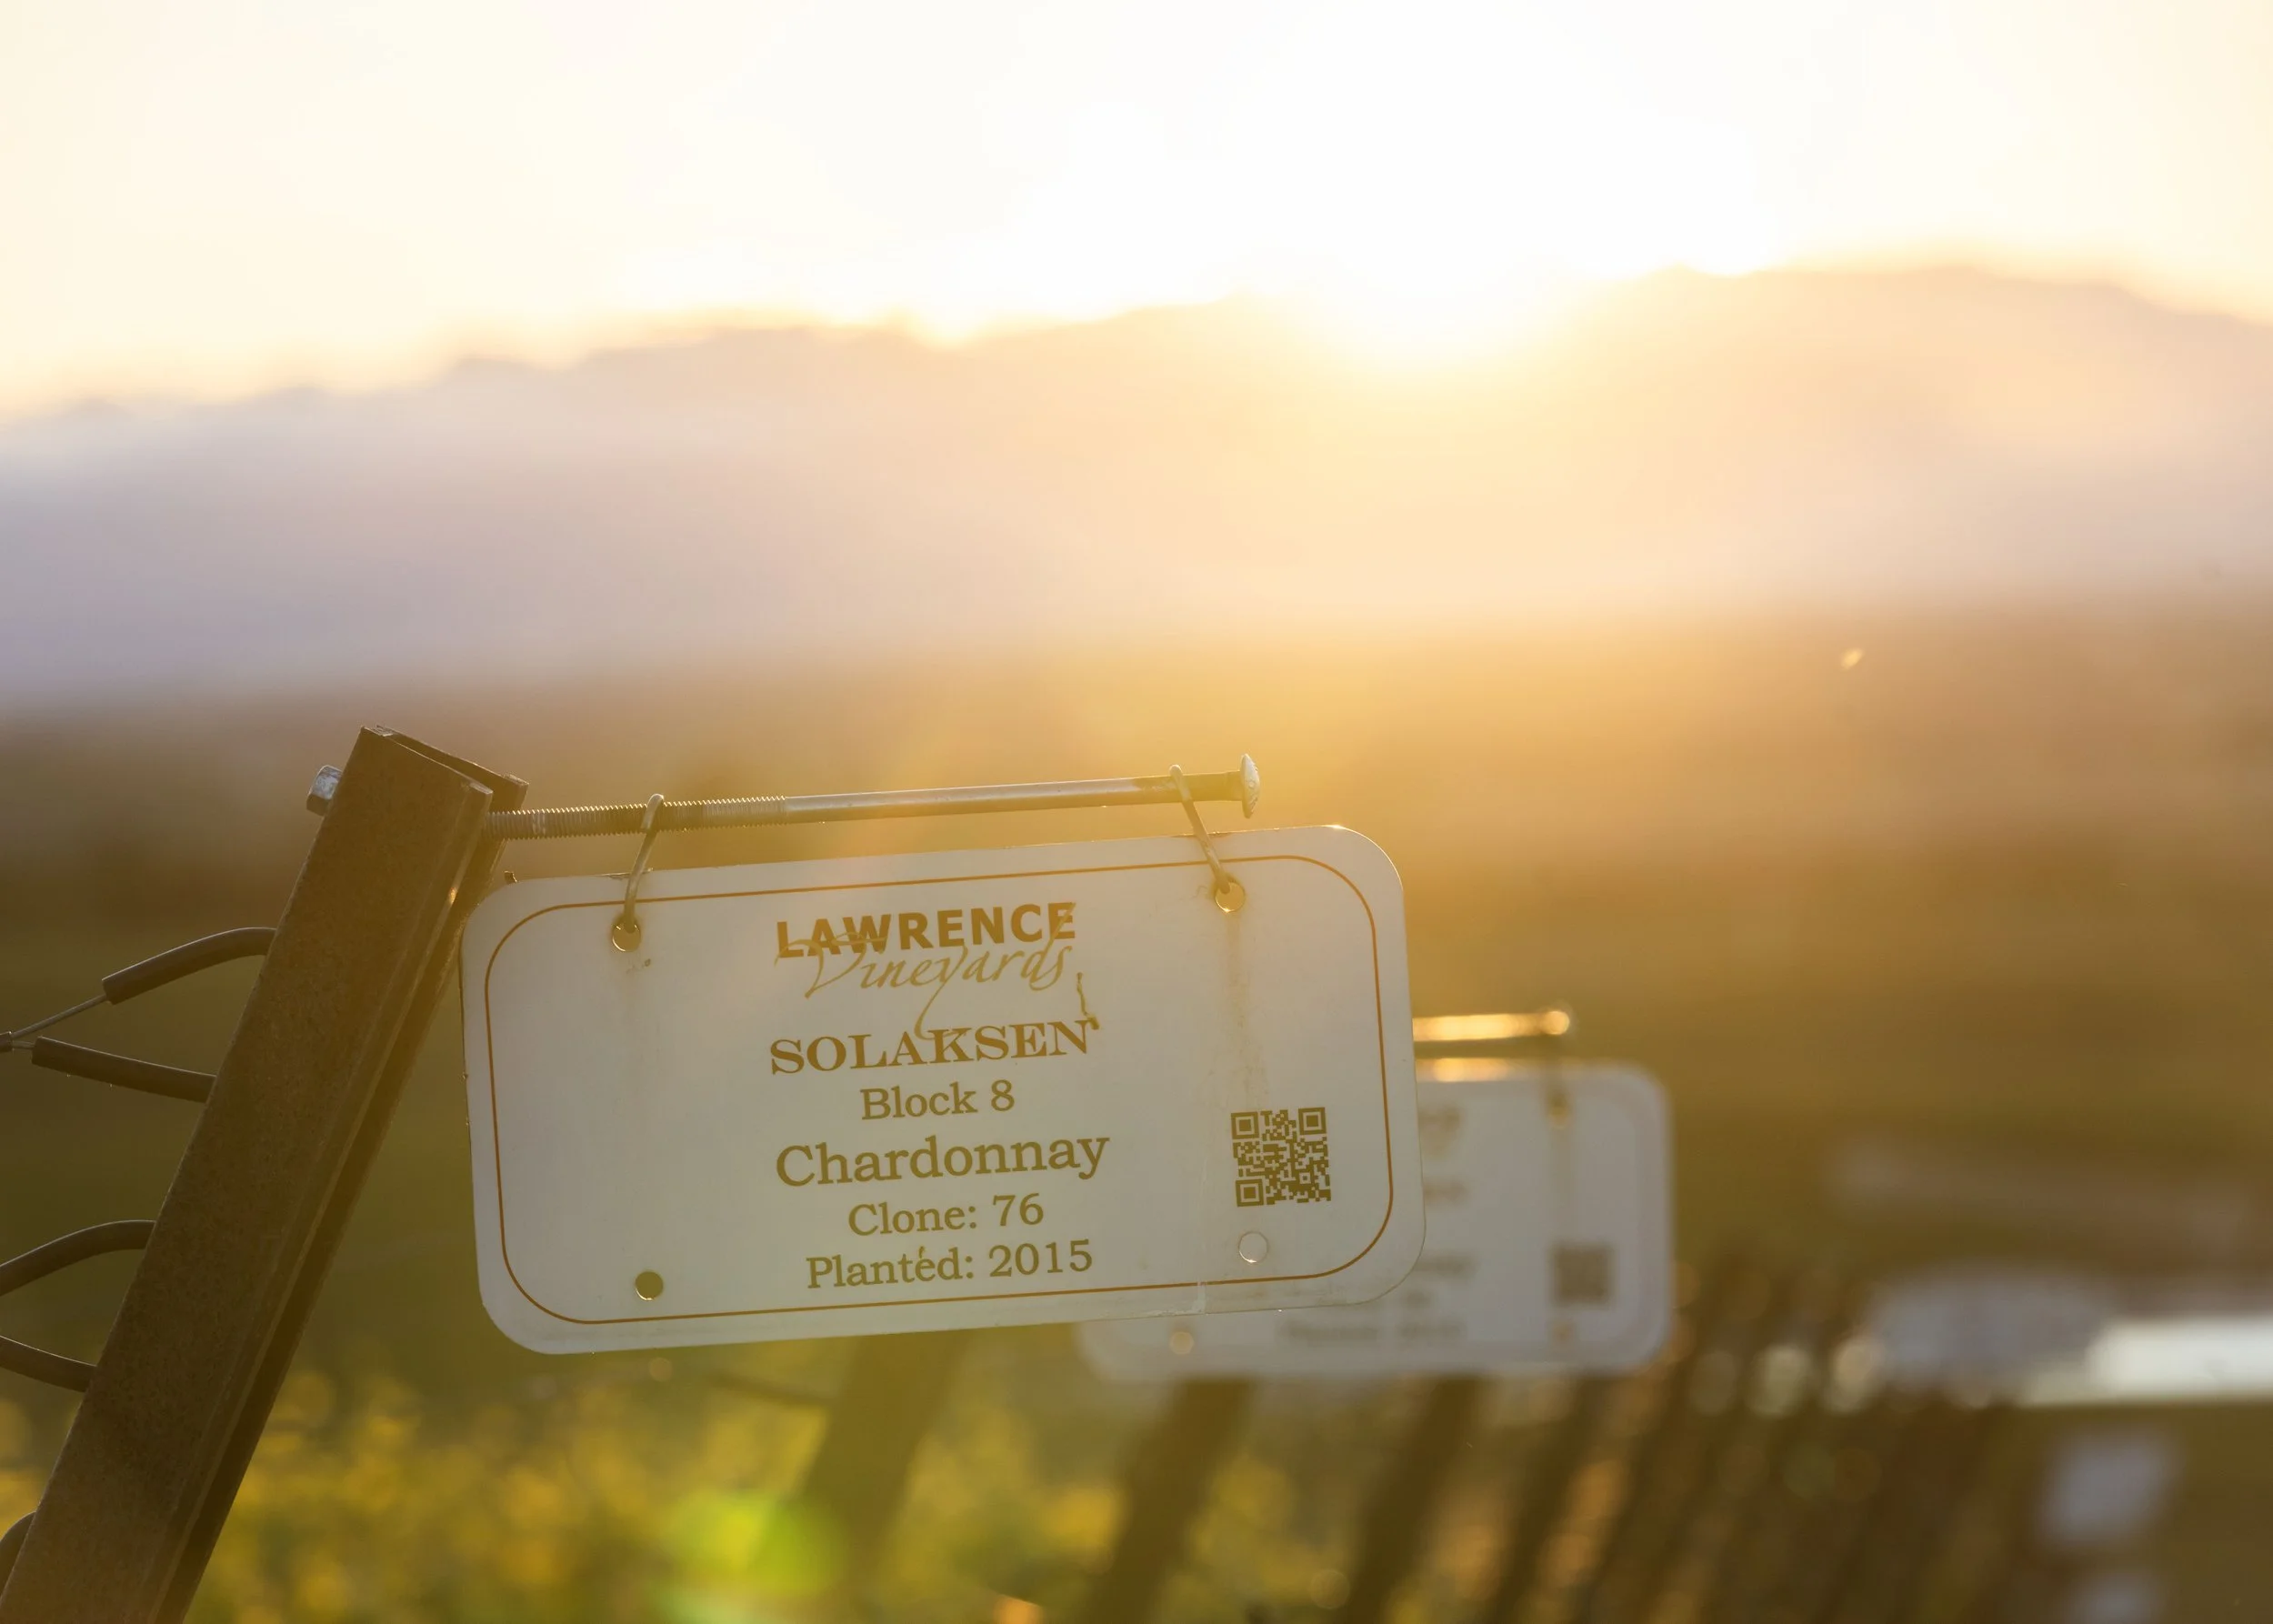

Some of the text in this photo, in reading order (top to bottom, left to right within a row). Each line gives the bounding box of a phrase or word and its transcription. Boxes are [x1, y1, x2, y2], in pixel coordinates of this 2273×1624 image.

[776, 902, 1076, 958] LAWRENCE
[774, 904, 1076, 1040] Vineyards
[769, 1019, 1093, 1075] SOLAKSEN
[860, 1079, 1015, 1120] Block 8
[776, 1135, 1110, 1187] Chardonnay
[848, 1193, 1044, 1236] Clone: 76
[806, 1238, 1092, 1288] Planted: 2015
